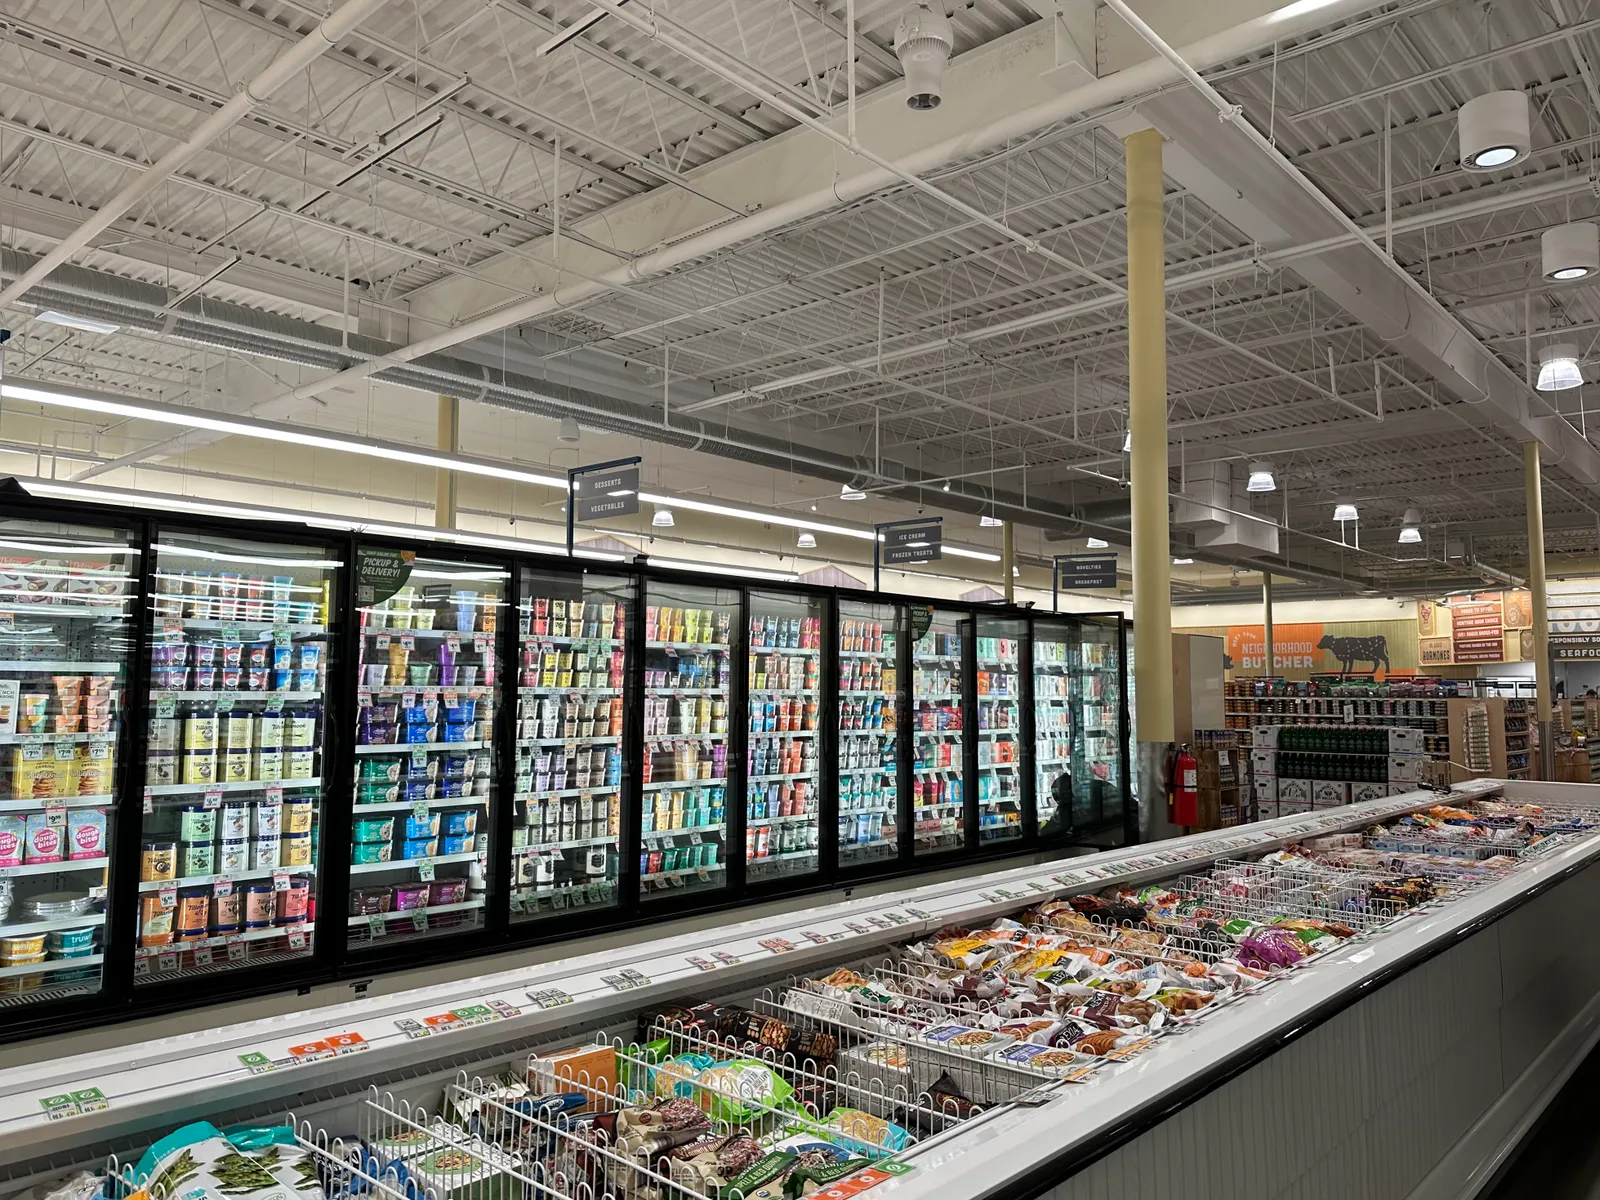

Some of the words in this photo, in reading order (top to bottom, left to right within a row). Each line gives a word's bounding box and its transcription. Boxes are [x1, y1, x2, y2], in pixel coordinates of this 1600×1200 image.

[594, 478, 621, 489] DESSERTS
[591, 501, 624, 512] VEGETABLES
[363, 557, 391, 567] PICKUP
[392, 559, 399, 568] &
[361, 566, 401, 577] DELIVERY!
[1232, 633, 1241, 647] MEET
[1243, 631, 1256, 639] YOUR
[1242, 641, 1313, 654] NEIGORHOOD
[1423, 650, 1450, 661] HORMONES
[34, 833, 59, 843] dough
[76, 829, 99, 839] dough
[38, 840, 57, 849] bites
[80, 836, 98, 845] bites
